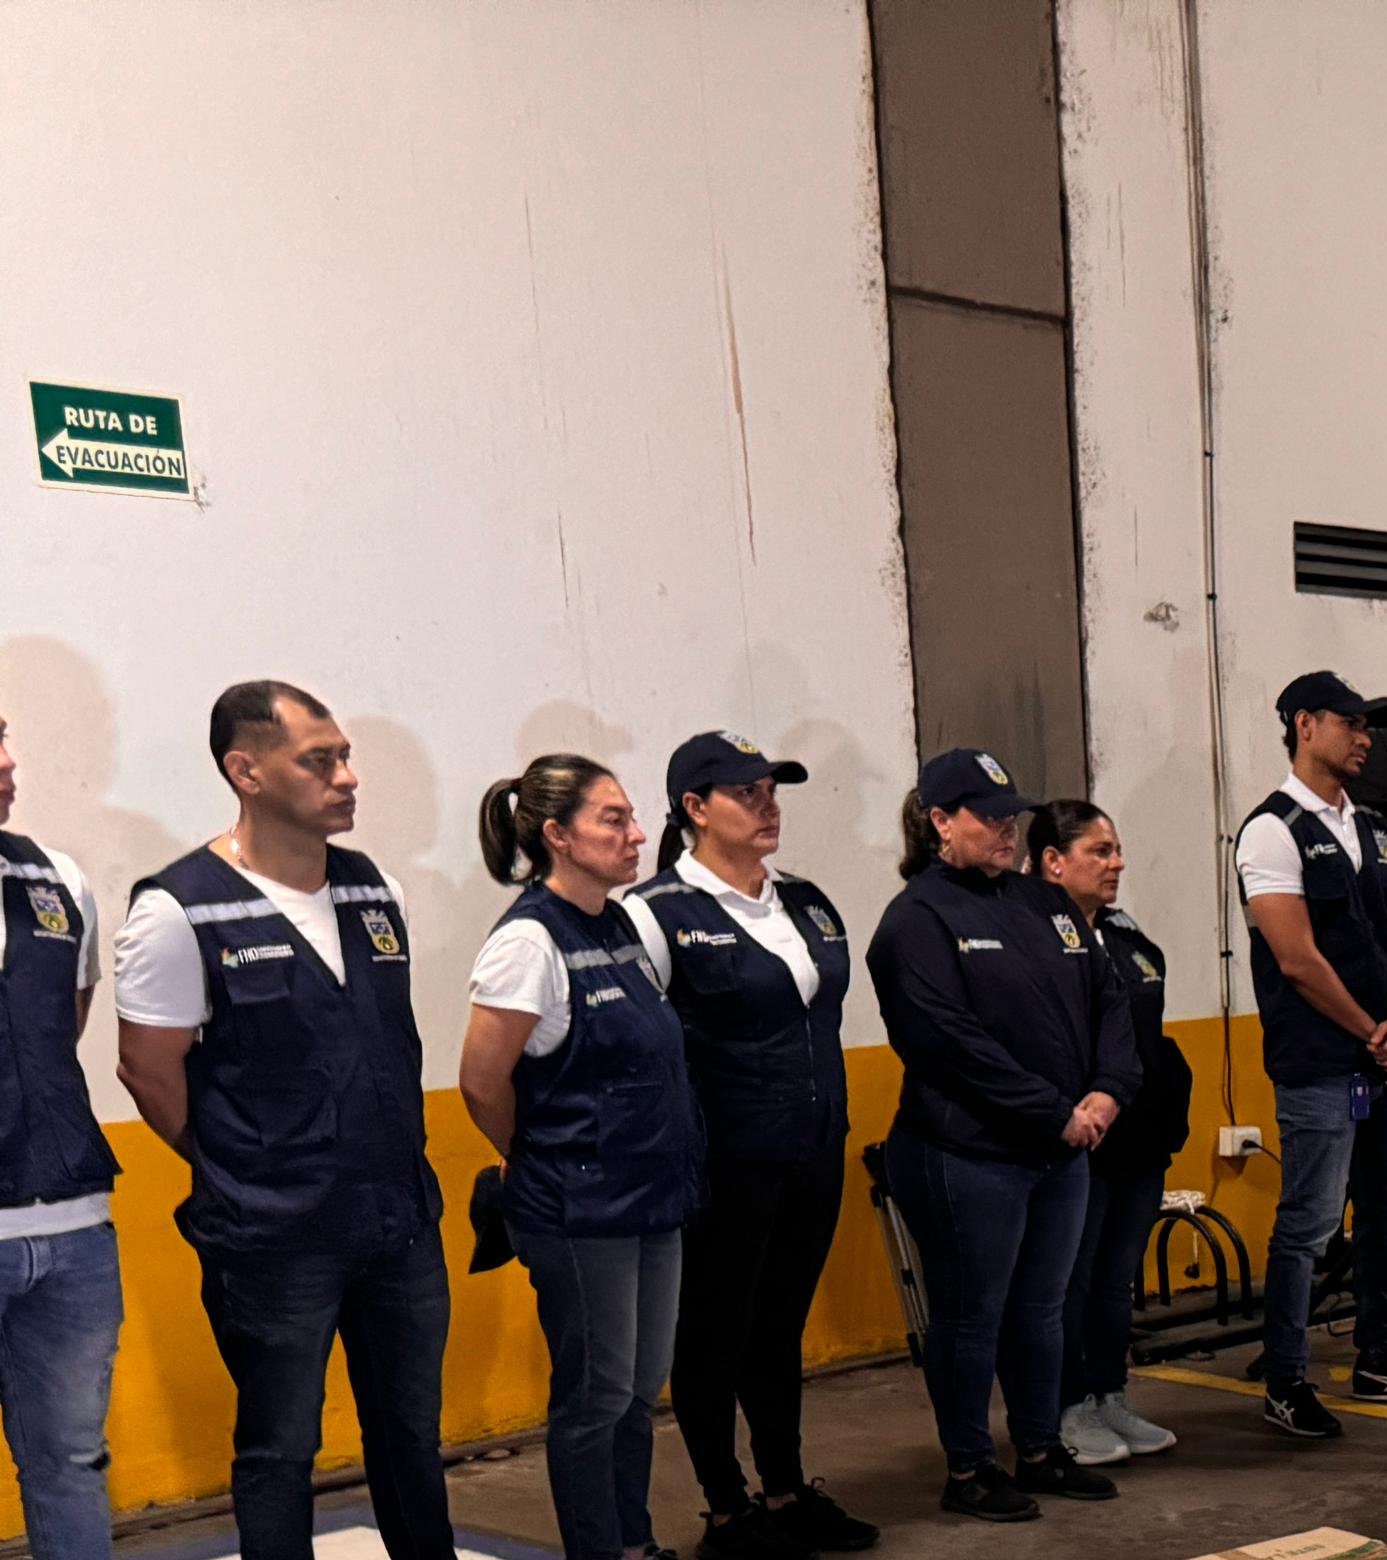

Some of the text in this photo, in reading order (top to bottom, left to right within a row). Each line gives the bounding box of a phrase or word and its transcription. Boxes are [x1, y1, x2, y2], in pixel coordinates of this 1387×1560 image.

[64, 406, 157, 435] RUTA DE
[56, 445, 181, 476] EVACUACIÓN
